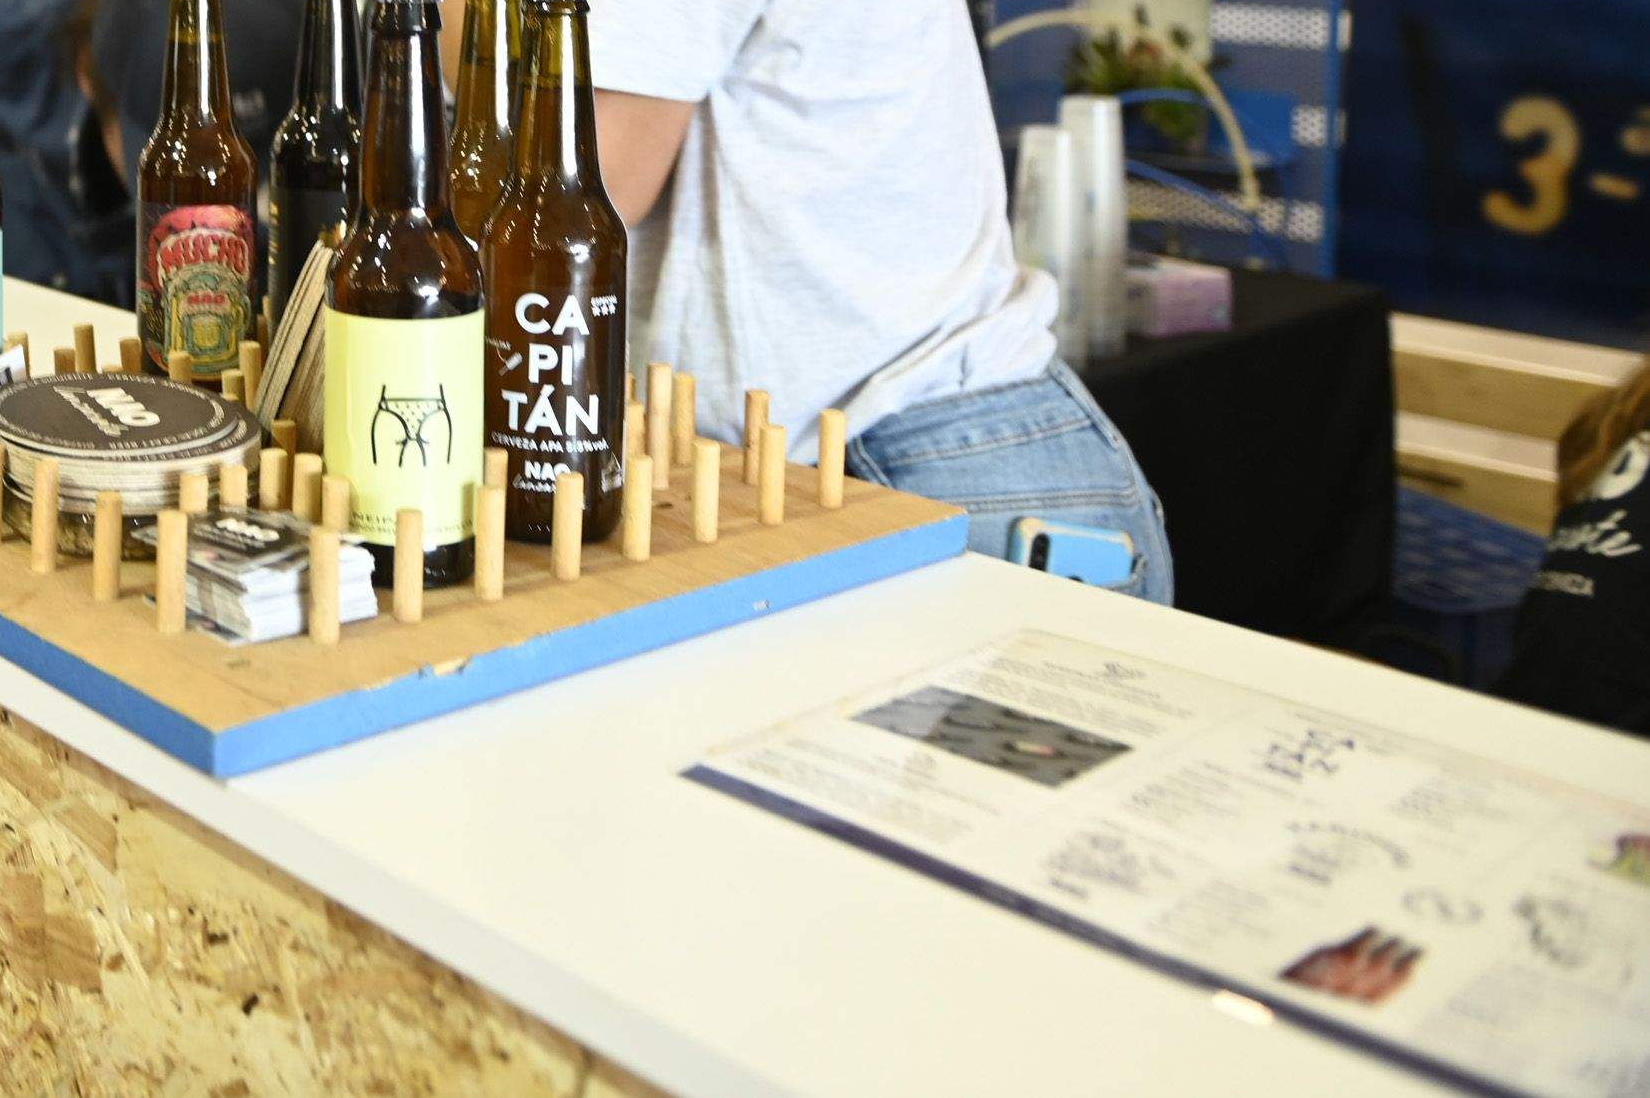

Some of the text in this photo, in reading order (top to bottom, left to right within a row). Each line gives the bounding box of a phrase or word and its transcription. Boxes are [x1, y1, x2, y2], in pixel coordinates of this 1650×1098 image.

[160, 233, 247, 277] MUCHO
[515, 292, 590, 335] CA
[528, 342, 574, 386] PI
[501, 383, 600, 436] TÁN
